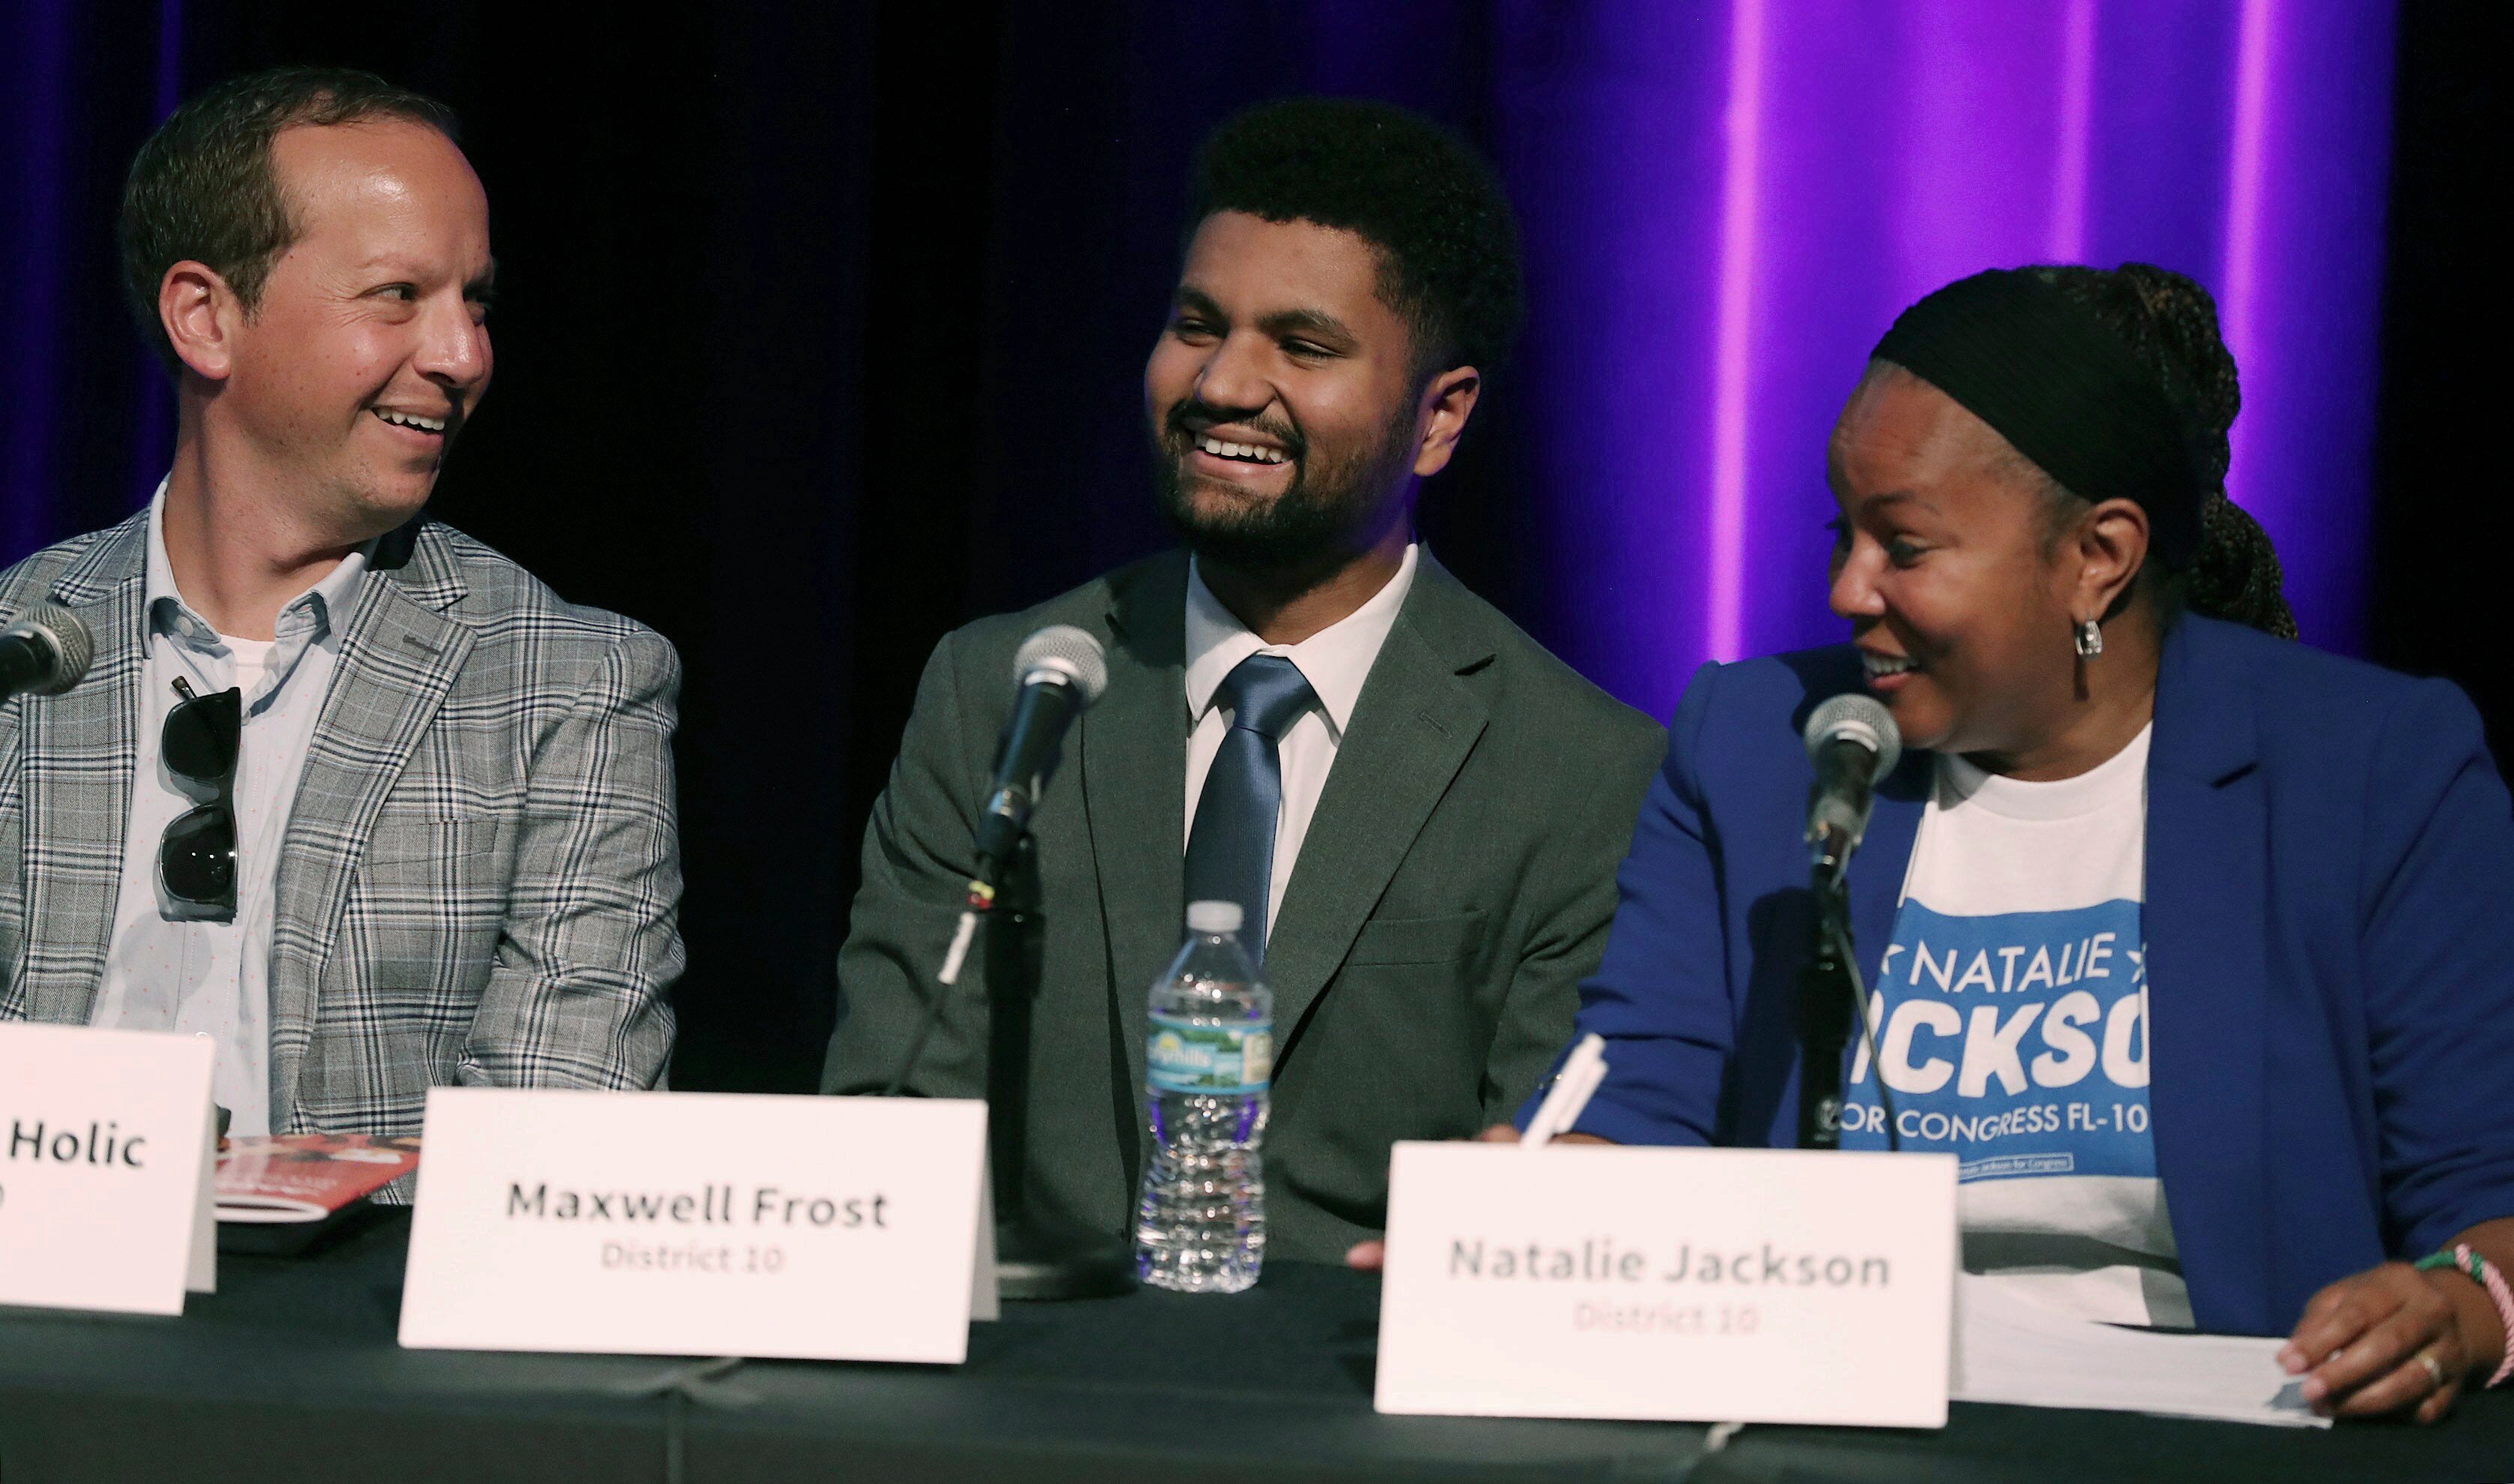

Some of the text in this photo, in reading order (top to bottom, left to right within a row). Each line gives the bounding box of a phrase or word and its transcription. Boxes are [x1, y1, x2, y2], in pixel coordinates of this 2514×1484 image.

[1910, 932, 2116, 993] NATALIE
[1850, 985, 2151, 1098] CKSO
[10, 1120, 146, 1168] Holic
[1840, 1102, 1886, 1134] OR
[1896, 1104, 2061, 1143] CONGRESS
[2067, 1102, 2149, 1133] FL-10
[507, 1181, 888, 1229] Maxwell Frost
[601, 1240, 787, 1275] District 10
[1448, 1236, 1892, 1288] Natalie Jackson
[1574, 1299, 1762, 1336] District 10
